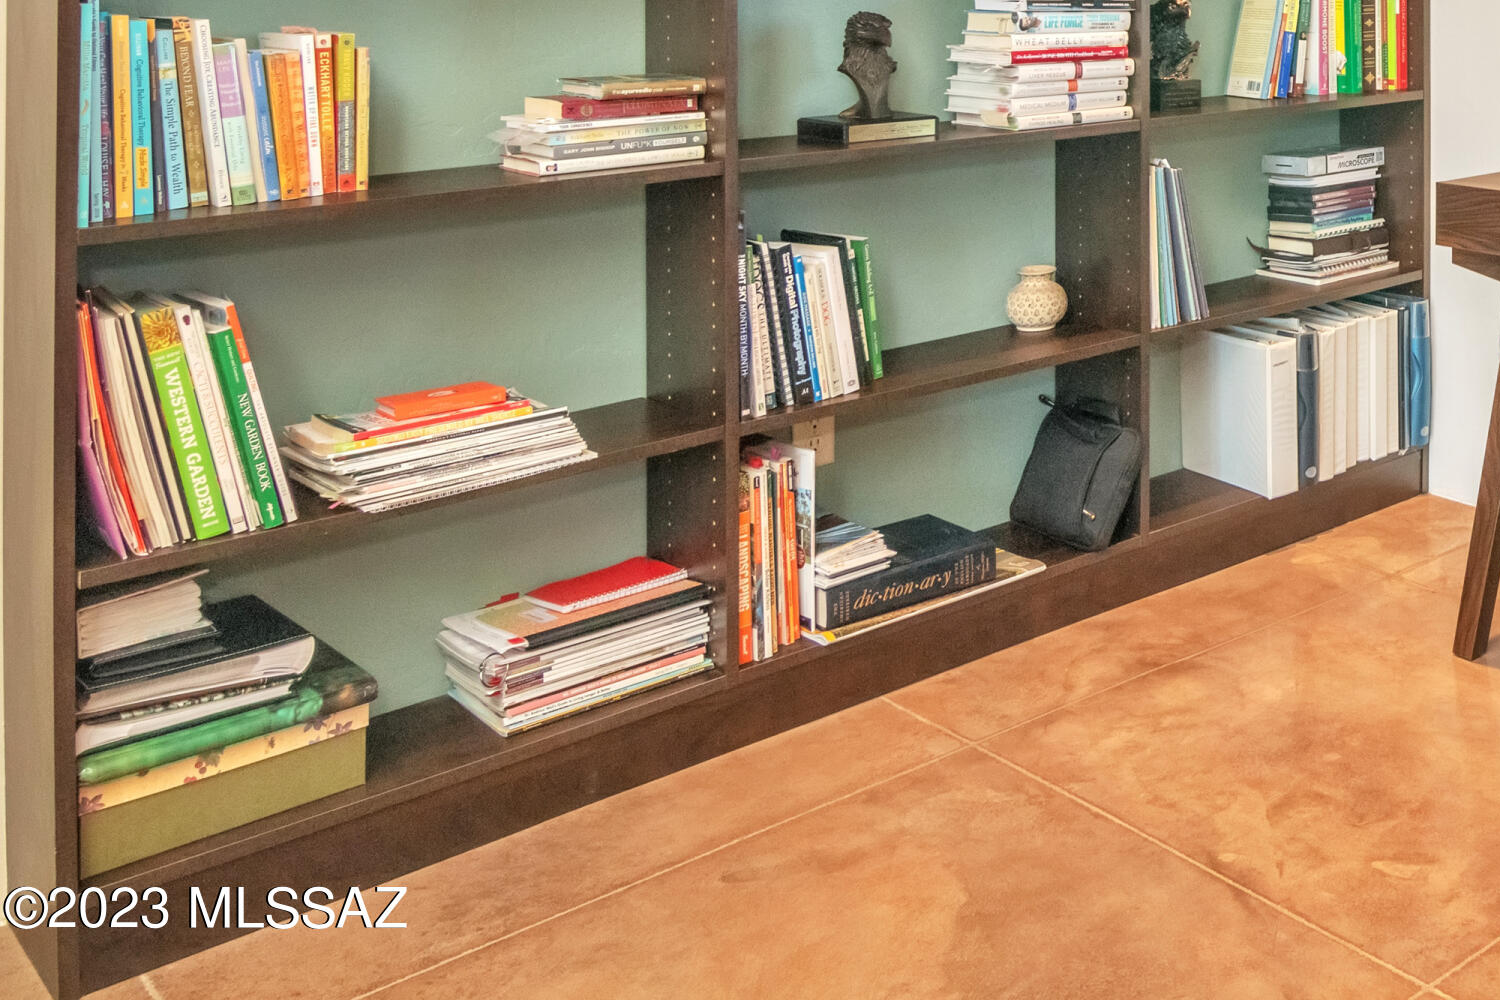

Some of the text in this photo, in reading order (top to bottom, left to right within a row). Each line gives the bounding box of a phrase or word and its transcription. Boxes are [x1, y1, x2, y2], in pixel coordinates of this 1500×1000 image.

[1016, 35, 1083, 46] WHEAT BELLY
[135, 59, 146, 146] Cognitive Behavioral Therapy
[180, 47, 195, 107] BEYOND FEAR
[320, 52, 331, 132] ECKHART TOLLE
[164, 82, 184, 195] The Simple Path to Wealth
[1338, 159, 1374, 168] MICROSCOPE
[738, 286, 746, 302] SKY
[739, 304, 747, 333] MONTH
[785, 275, 806, 375] Digital Photography
[740, 336, 747, 345] BY
[740, 348, 748, 375] MONTH
[165, 368, 215, 519] WESTERN GARDEN
[238, 392, 271, 492] NEW GARDEN BOOK
[739, 534, 749, 612] LANDSCAPING
